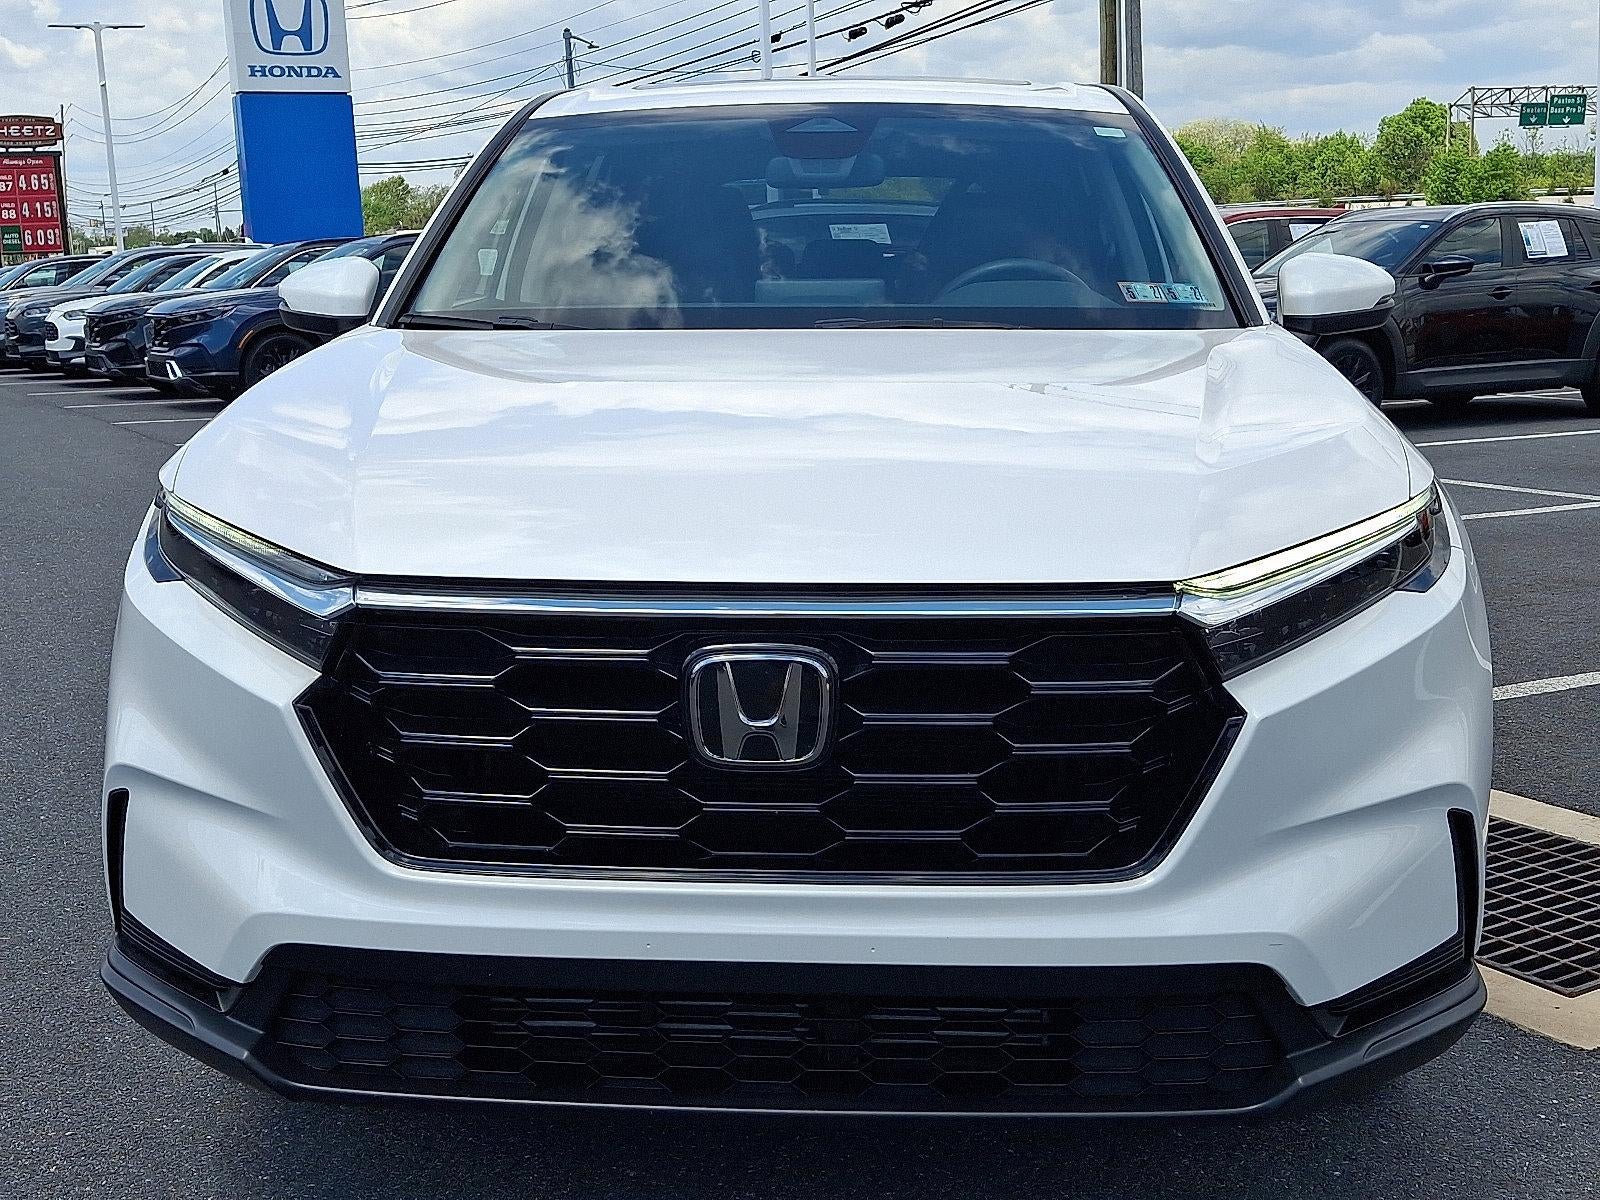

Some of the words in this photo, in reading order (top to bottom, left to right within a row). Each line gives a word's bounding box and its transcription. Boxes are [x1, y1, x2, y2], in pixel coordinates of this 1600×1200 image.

[247, 65, 342, 78] HONDA
[1553, 96, 1575, 104] Paxton
[1576, 96, 1584, 104] St
[1, 209, 17, 219] 88
